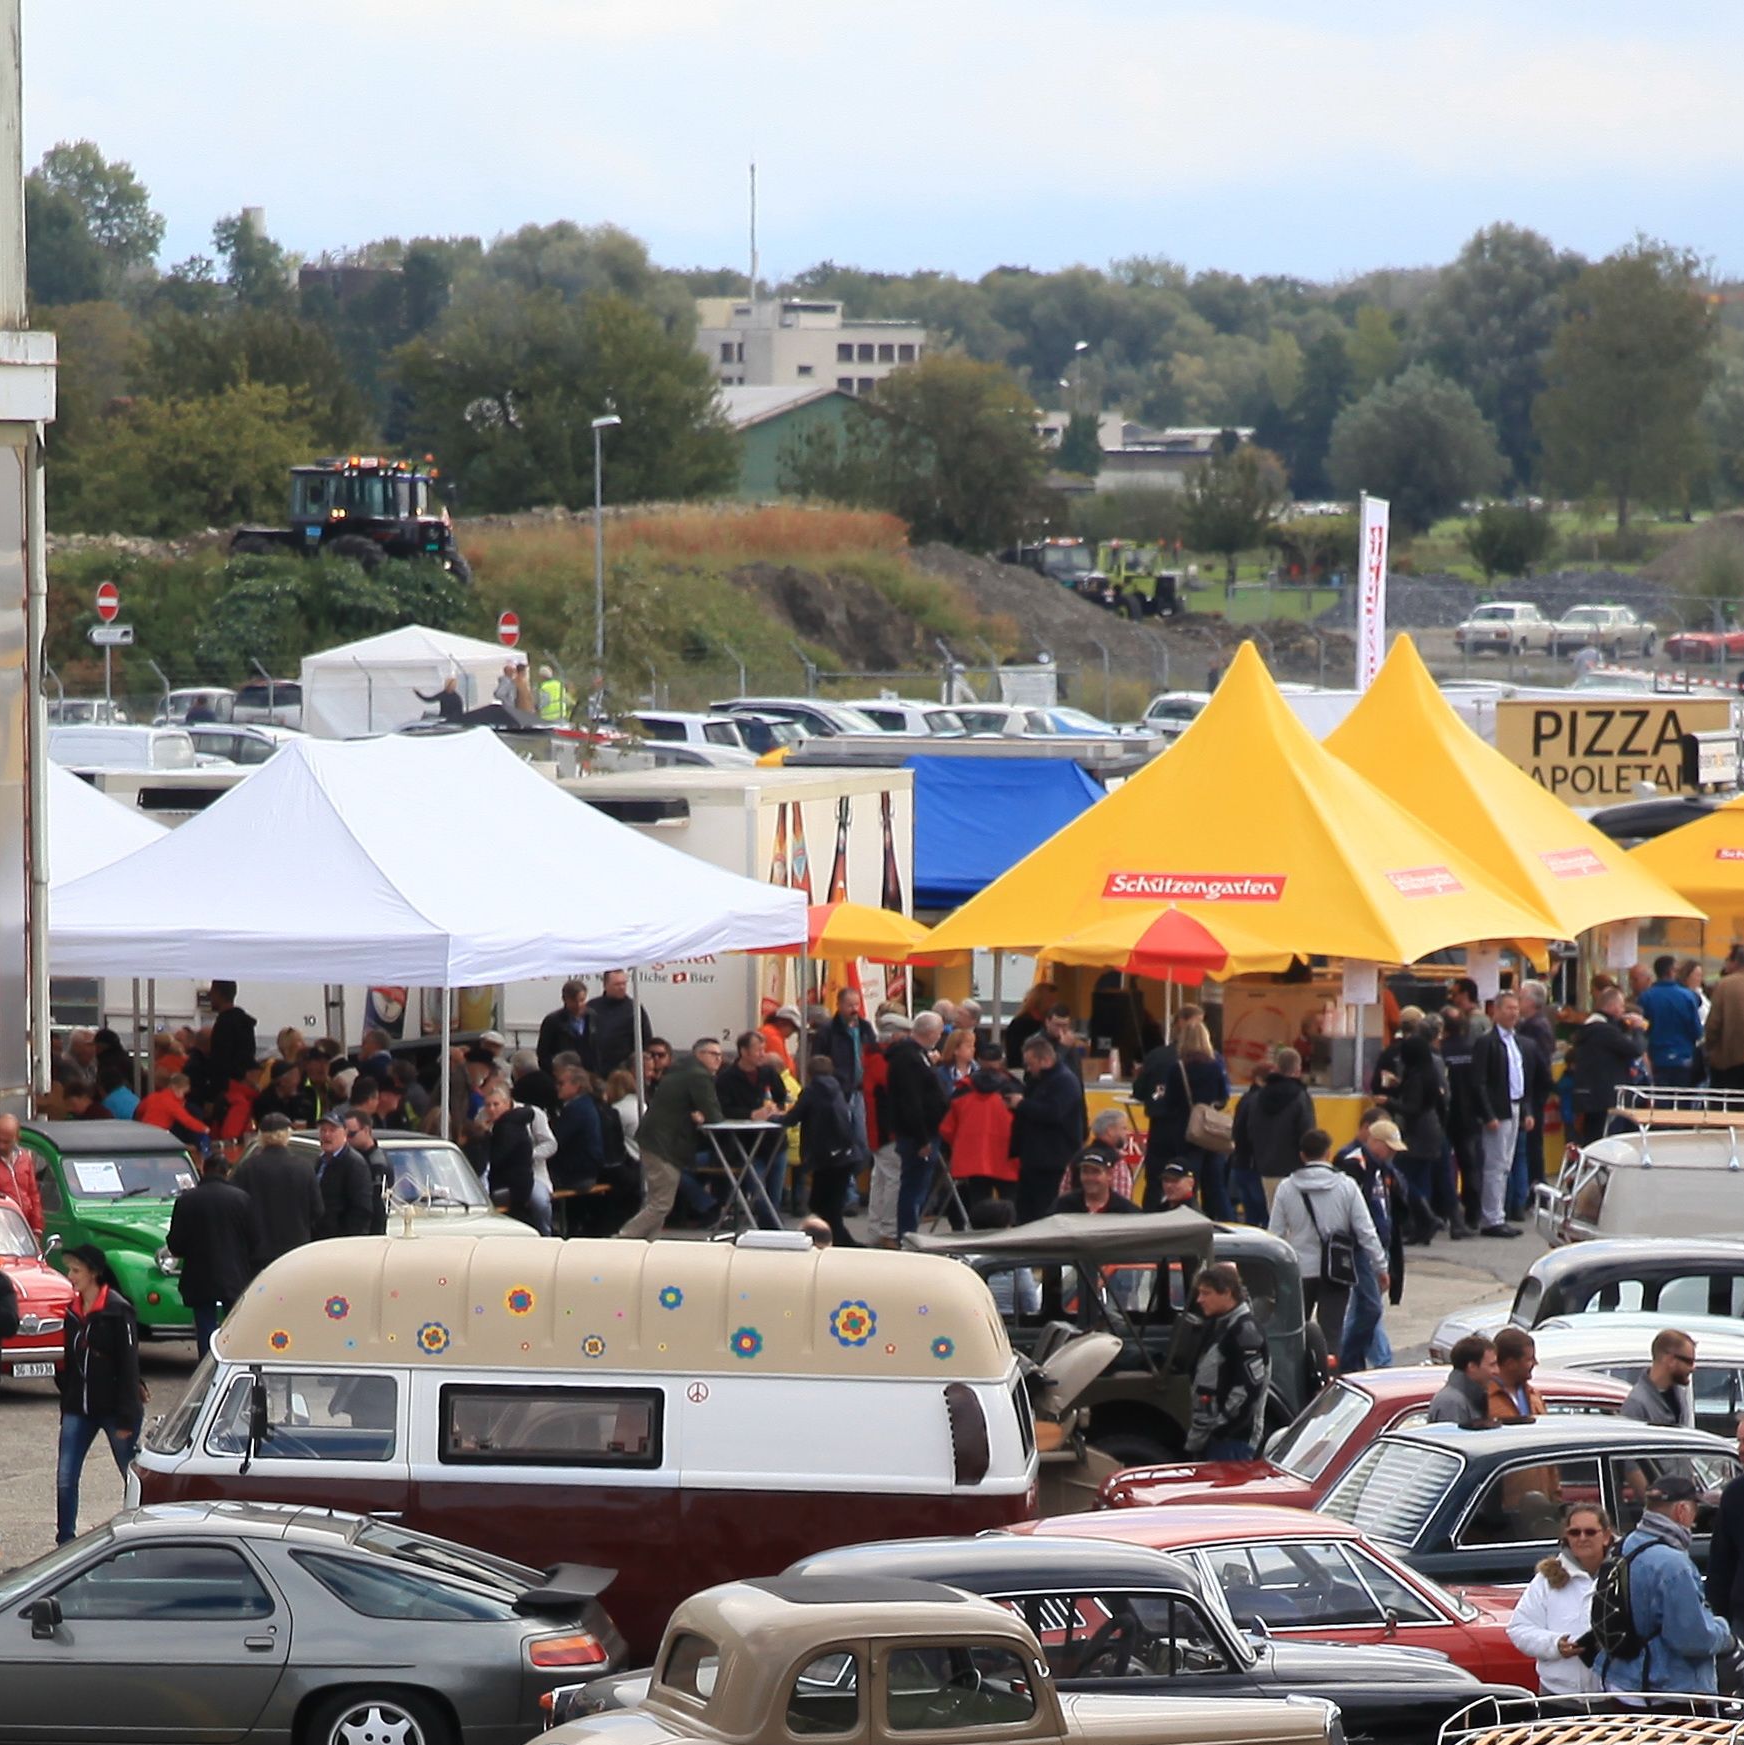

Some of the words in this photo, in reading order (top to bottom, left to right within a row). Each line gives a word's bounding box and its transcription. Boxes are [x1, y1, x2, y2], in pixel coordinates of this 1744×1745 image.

[1532, 709, 1685, 757] PIZZA
[1519, 764, 1684, 794] APOLETA
[1112, 874, 1277, 899] Schützengarten
[722, 1028, 731, 1040] 2
